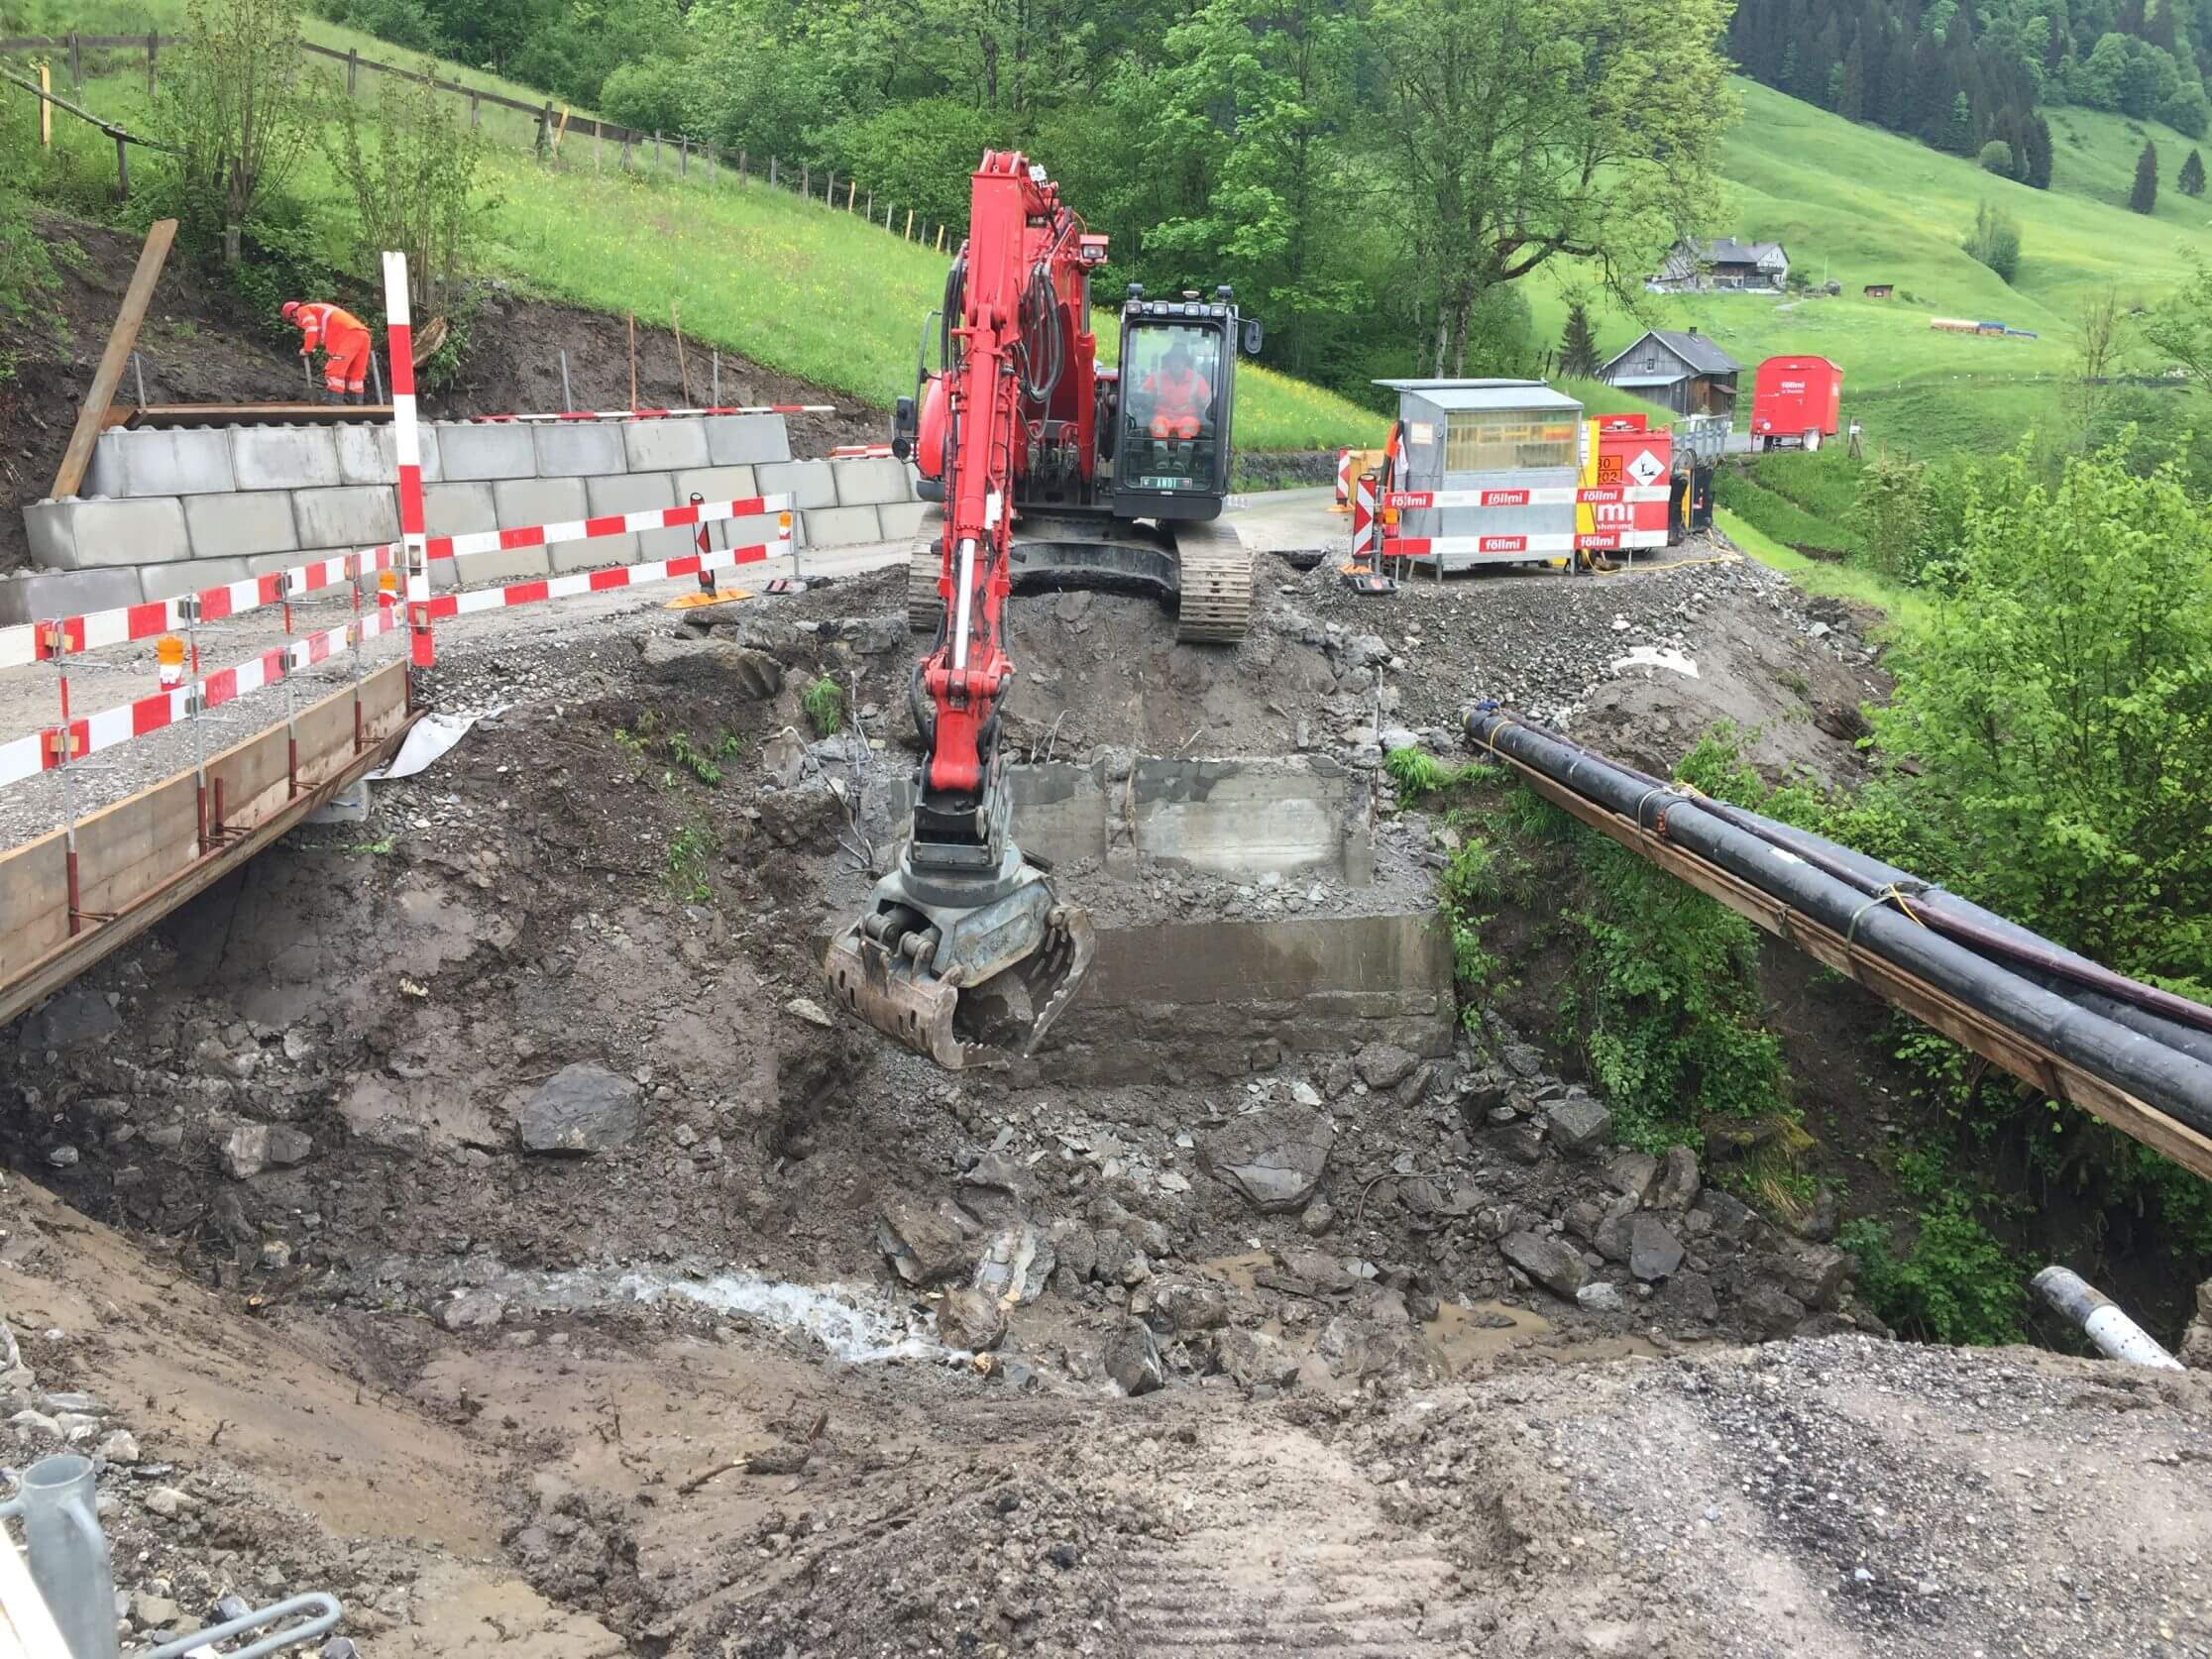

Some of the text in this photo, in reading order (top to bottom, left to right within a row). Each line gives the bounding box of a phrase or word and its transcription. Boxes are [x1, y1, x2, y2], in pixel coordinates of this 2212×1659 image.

[1488, 493, 1522, 504] föllmi
[1583, 490, 1617, 500] föllmi
[1486, 538, 1520, 550] föllmi
[1581, 535, 1614, 547] föllmi
